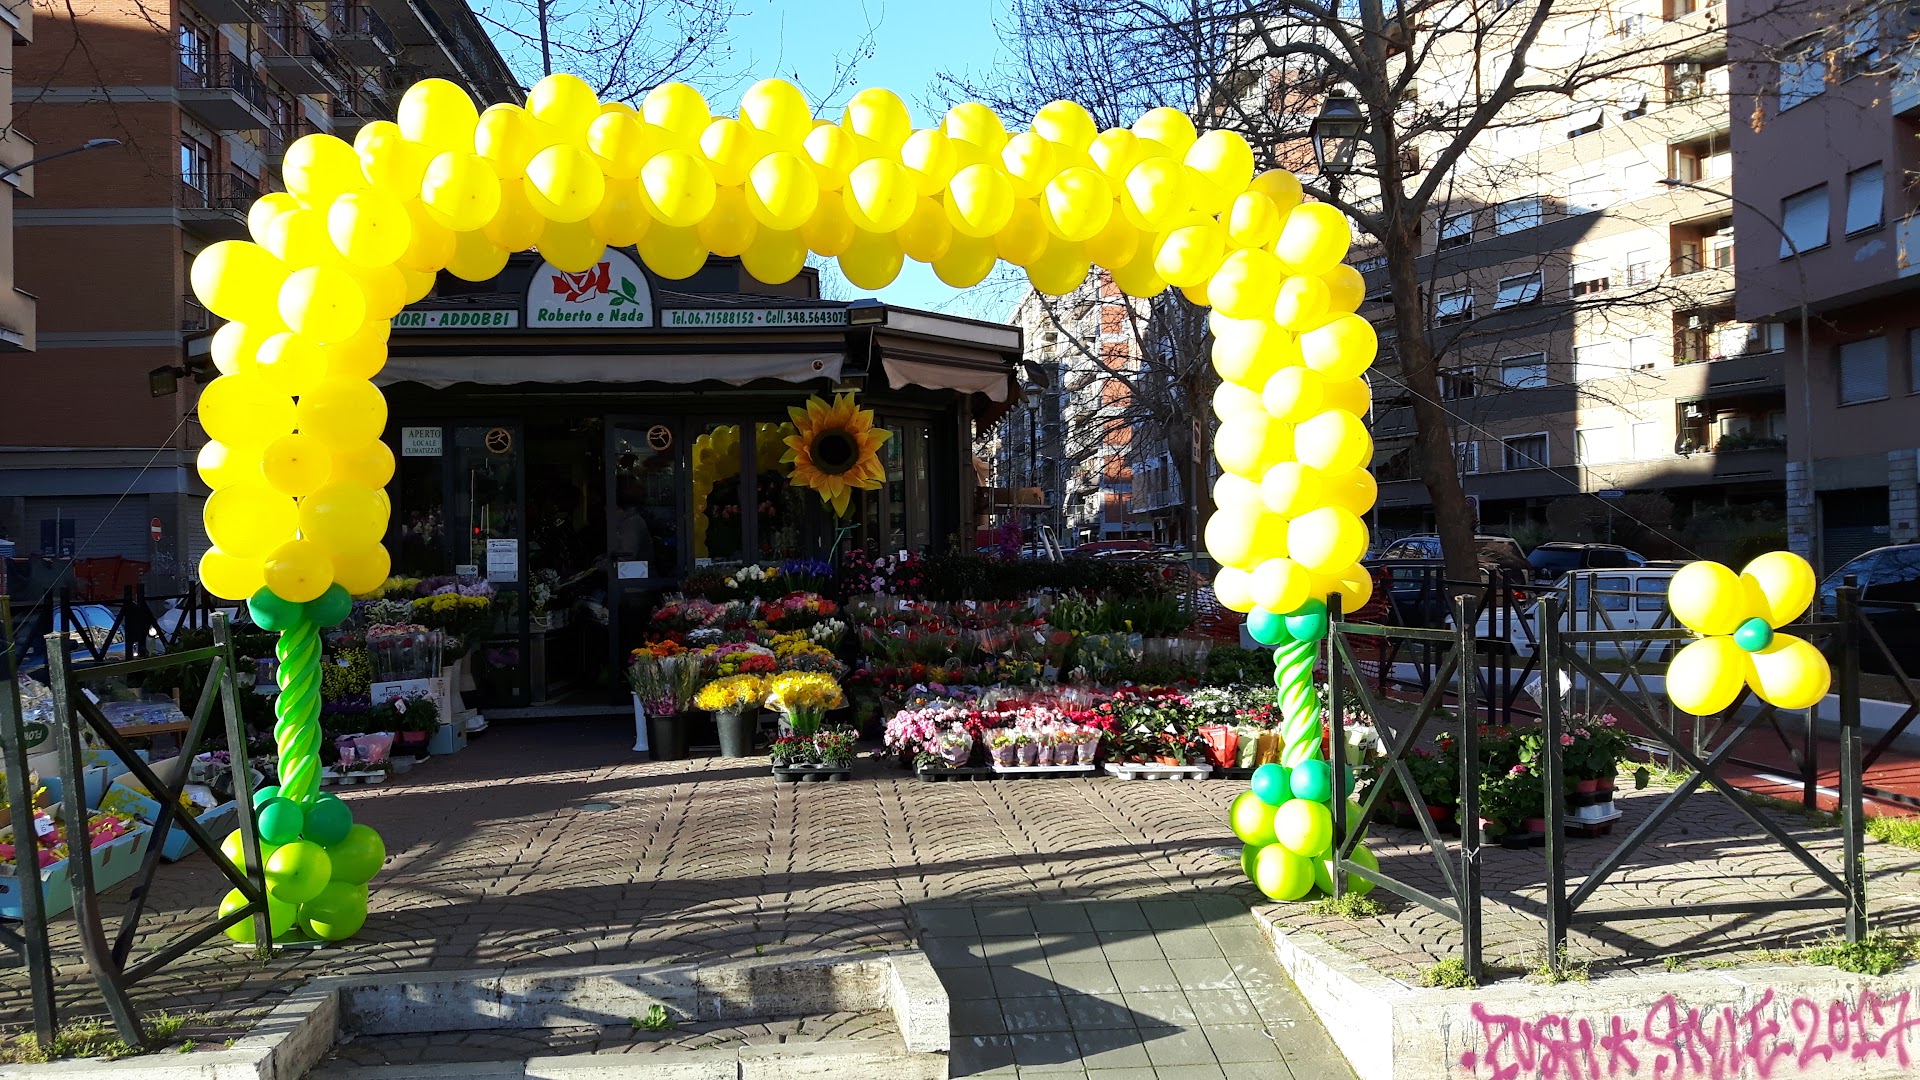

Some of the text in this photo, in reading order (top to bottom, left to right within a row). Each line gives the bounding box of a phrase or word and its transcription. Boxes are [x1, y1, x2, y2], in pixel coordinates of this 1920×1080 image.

[392, 312, 510, 326] IORI ADDOBBI
[537, 307, 644, 322] Roberto e Nada
[408, 429, 441, 438] APERTO
[412, 439, 437, 447] LOCALE
